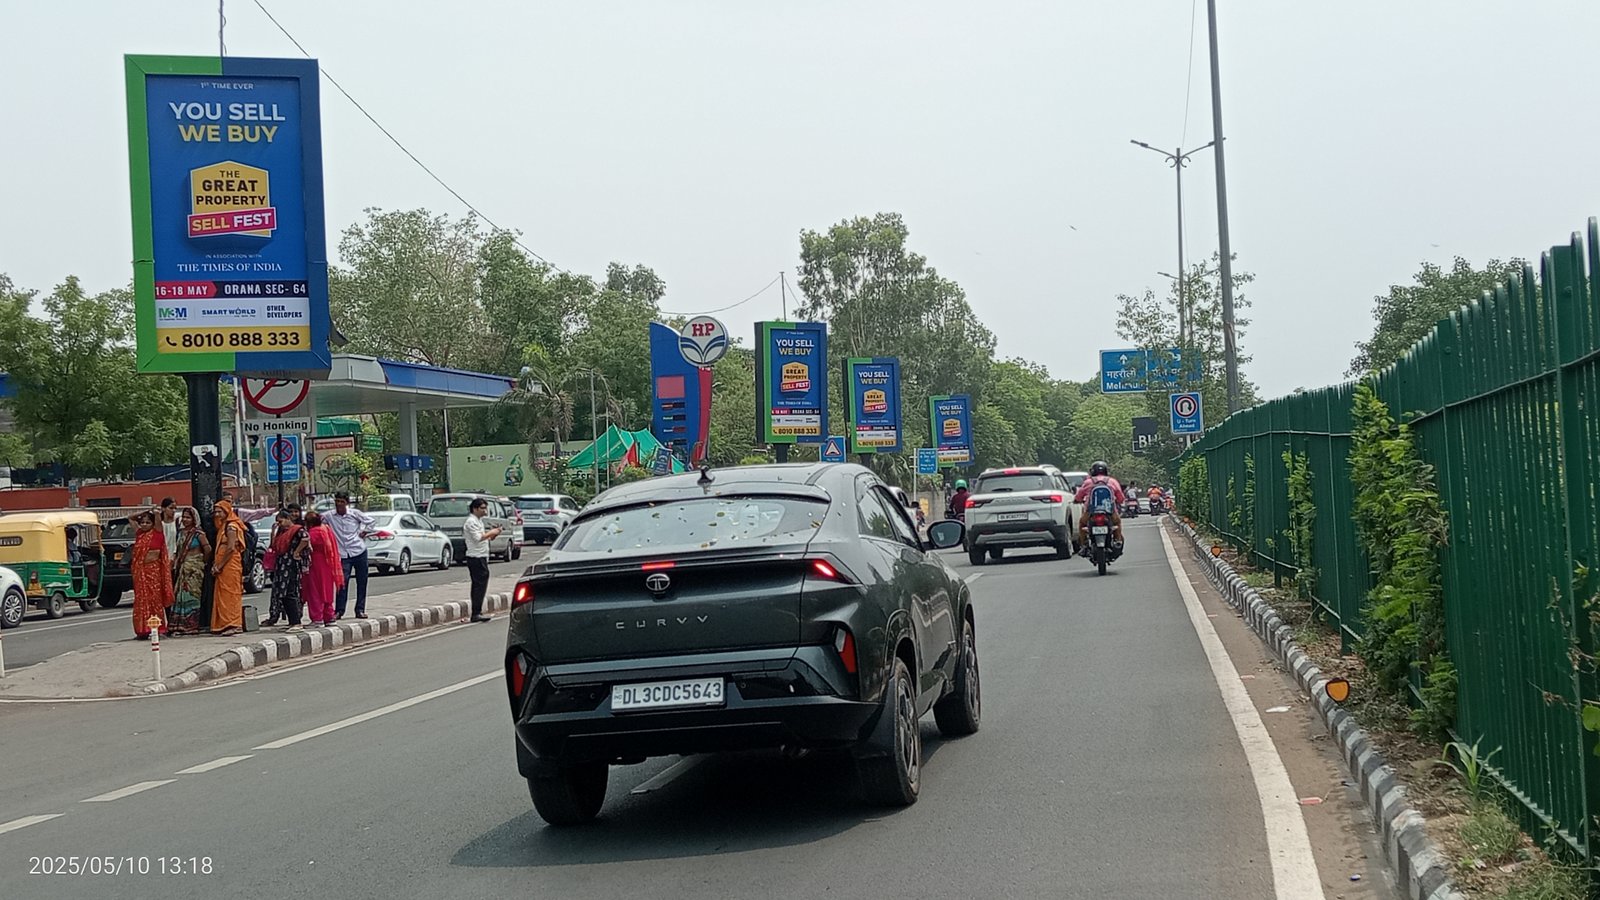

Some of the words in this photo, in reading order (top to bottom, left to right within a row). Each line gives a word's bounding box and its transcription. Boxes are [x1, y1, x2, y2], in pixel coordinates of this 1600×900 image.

[169, 102, 222, 120] YOU
[228, 103, 286, 121] SELL
[178, 124, 221, 142] WE
[228, 125, 278, 143] BUY
[220, 170, 240, 178] THE
[202, 180, 258, 192] GREAT
[196, 195, 266, 205] PROPERTY
[192, 217, 230, 231] SELL
[234, 212, 272, 228] FEST
[177, 264, 200, 272] THE
[202, 263, 234, 272] TIMES
[236, 263, 251, 271] OF
[254, 263, 282, 271] INDIA
[155, 286, 184, 296] 16-18
[187, 285, 208, 295] MAY
[224, 284, 262, 294] ORANA
[293, 284, 306, 294] 64
[692, 323, 715, 336] HP
[182, 333, 224, 347] 8010
[229, 333, 262, 346] 888
[268, 332, 300, 346] 333
[776, 338, 794, 347] YOU
[795, 339, 815, 347] SELL
[245, 423, 259, 431] No
[263, 421, 308, 430] Honking
[616, 615, 708, 629] CURVV
[623, 682, 722, 704] DL3CDC5643
